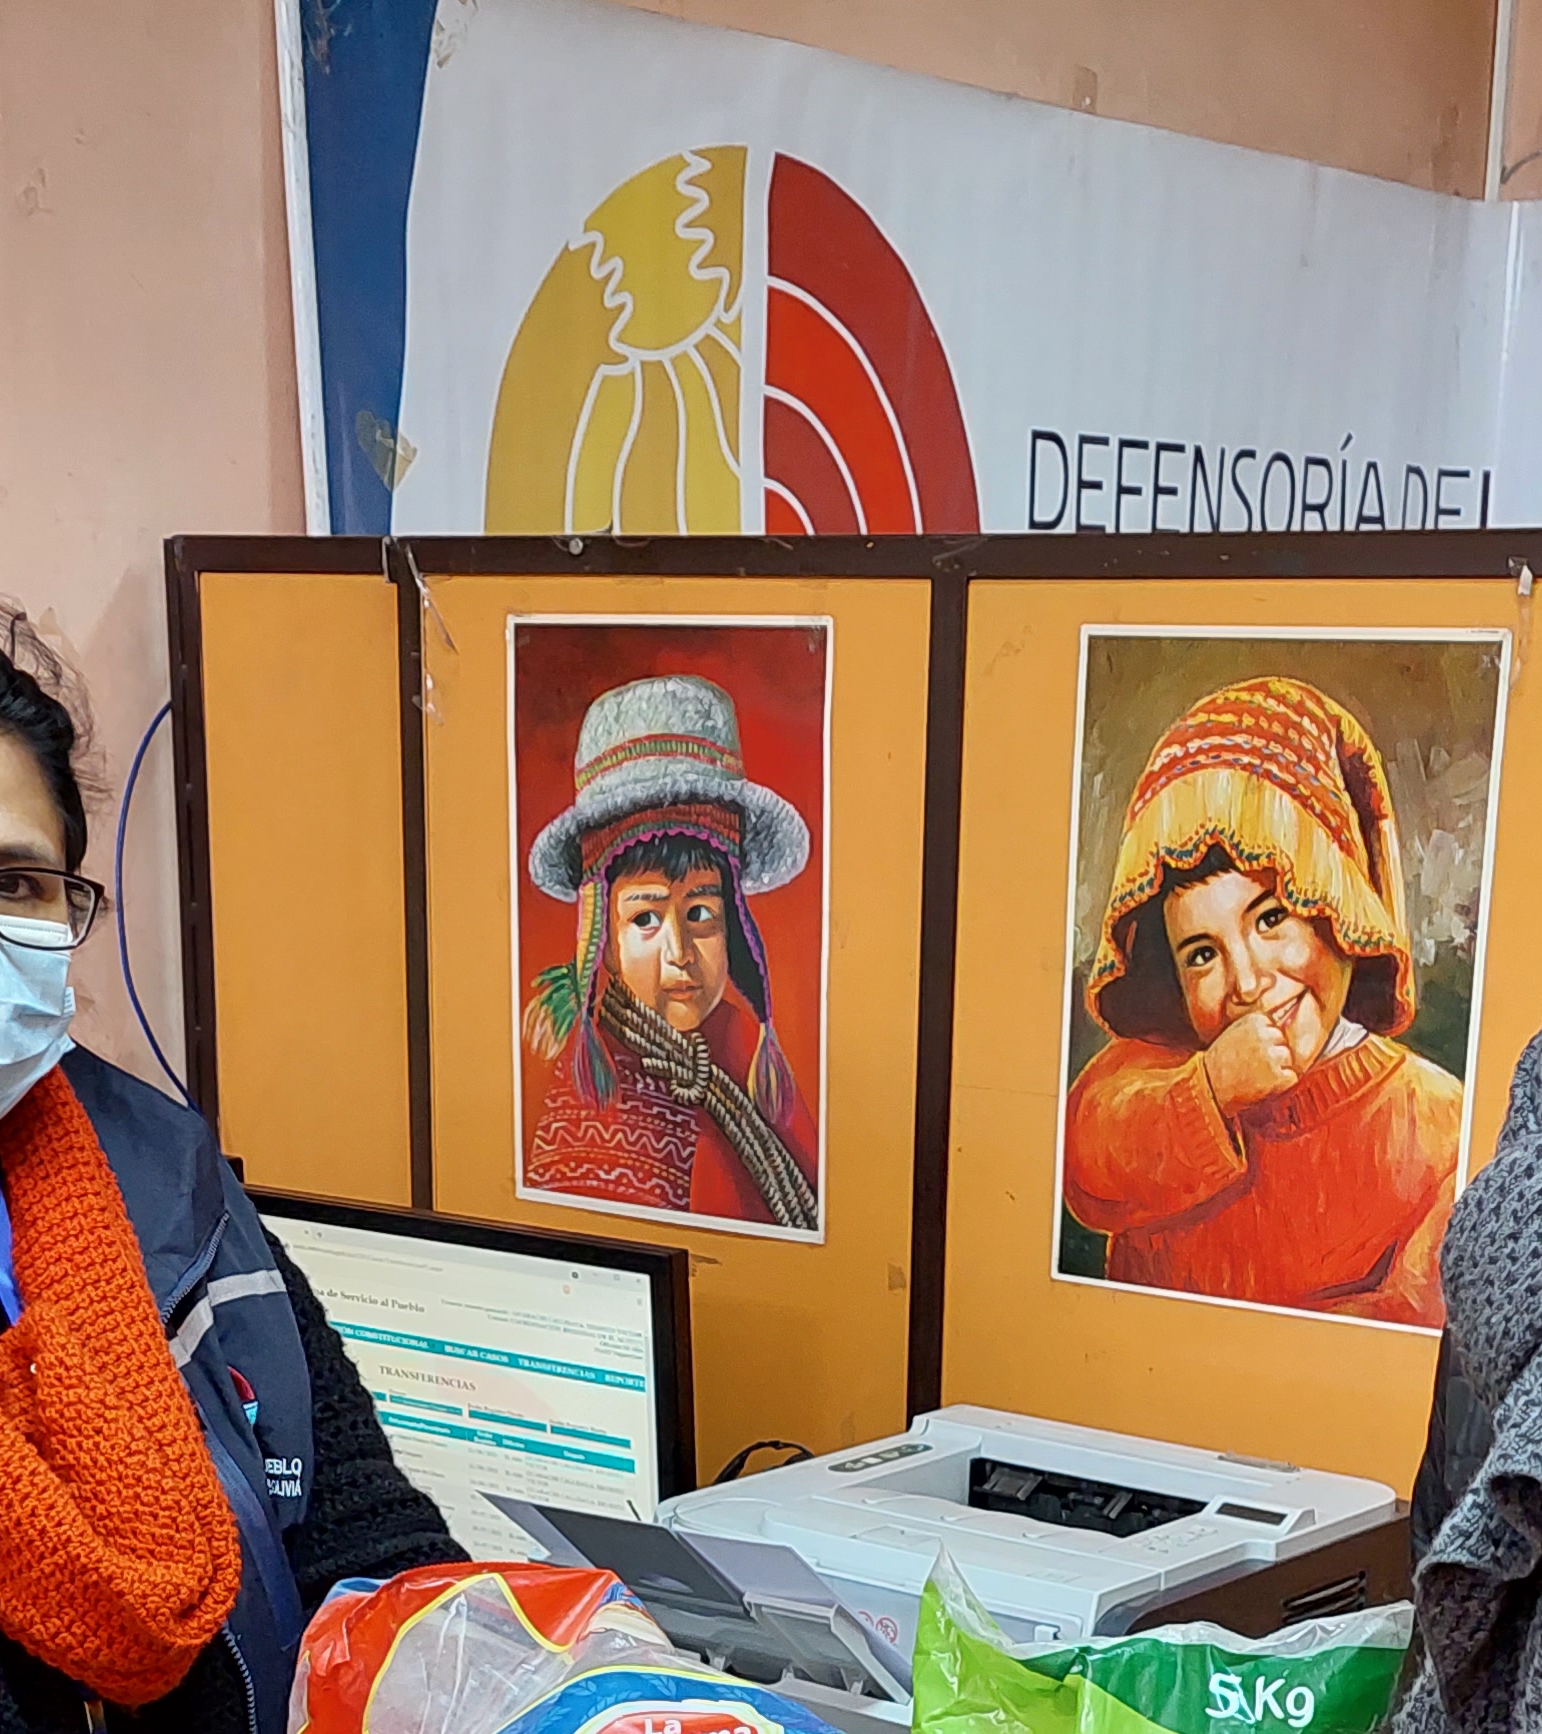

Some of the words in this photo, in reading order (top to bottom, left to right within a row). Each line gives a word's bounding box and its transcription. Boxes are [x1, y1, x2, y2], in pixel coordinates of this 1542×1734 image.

[1028, 427, 1387, 533] DEFENSORÍA
[340, 1290, 379, 1306] Servicio
[380, 1295, 390, 1307] al
[391, 1297, 426, 1314] Pueblo
[378, 1364, 477, 1392] TRANSFERENCIAS
[1255, 1675, 1315, 1729] Kg
